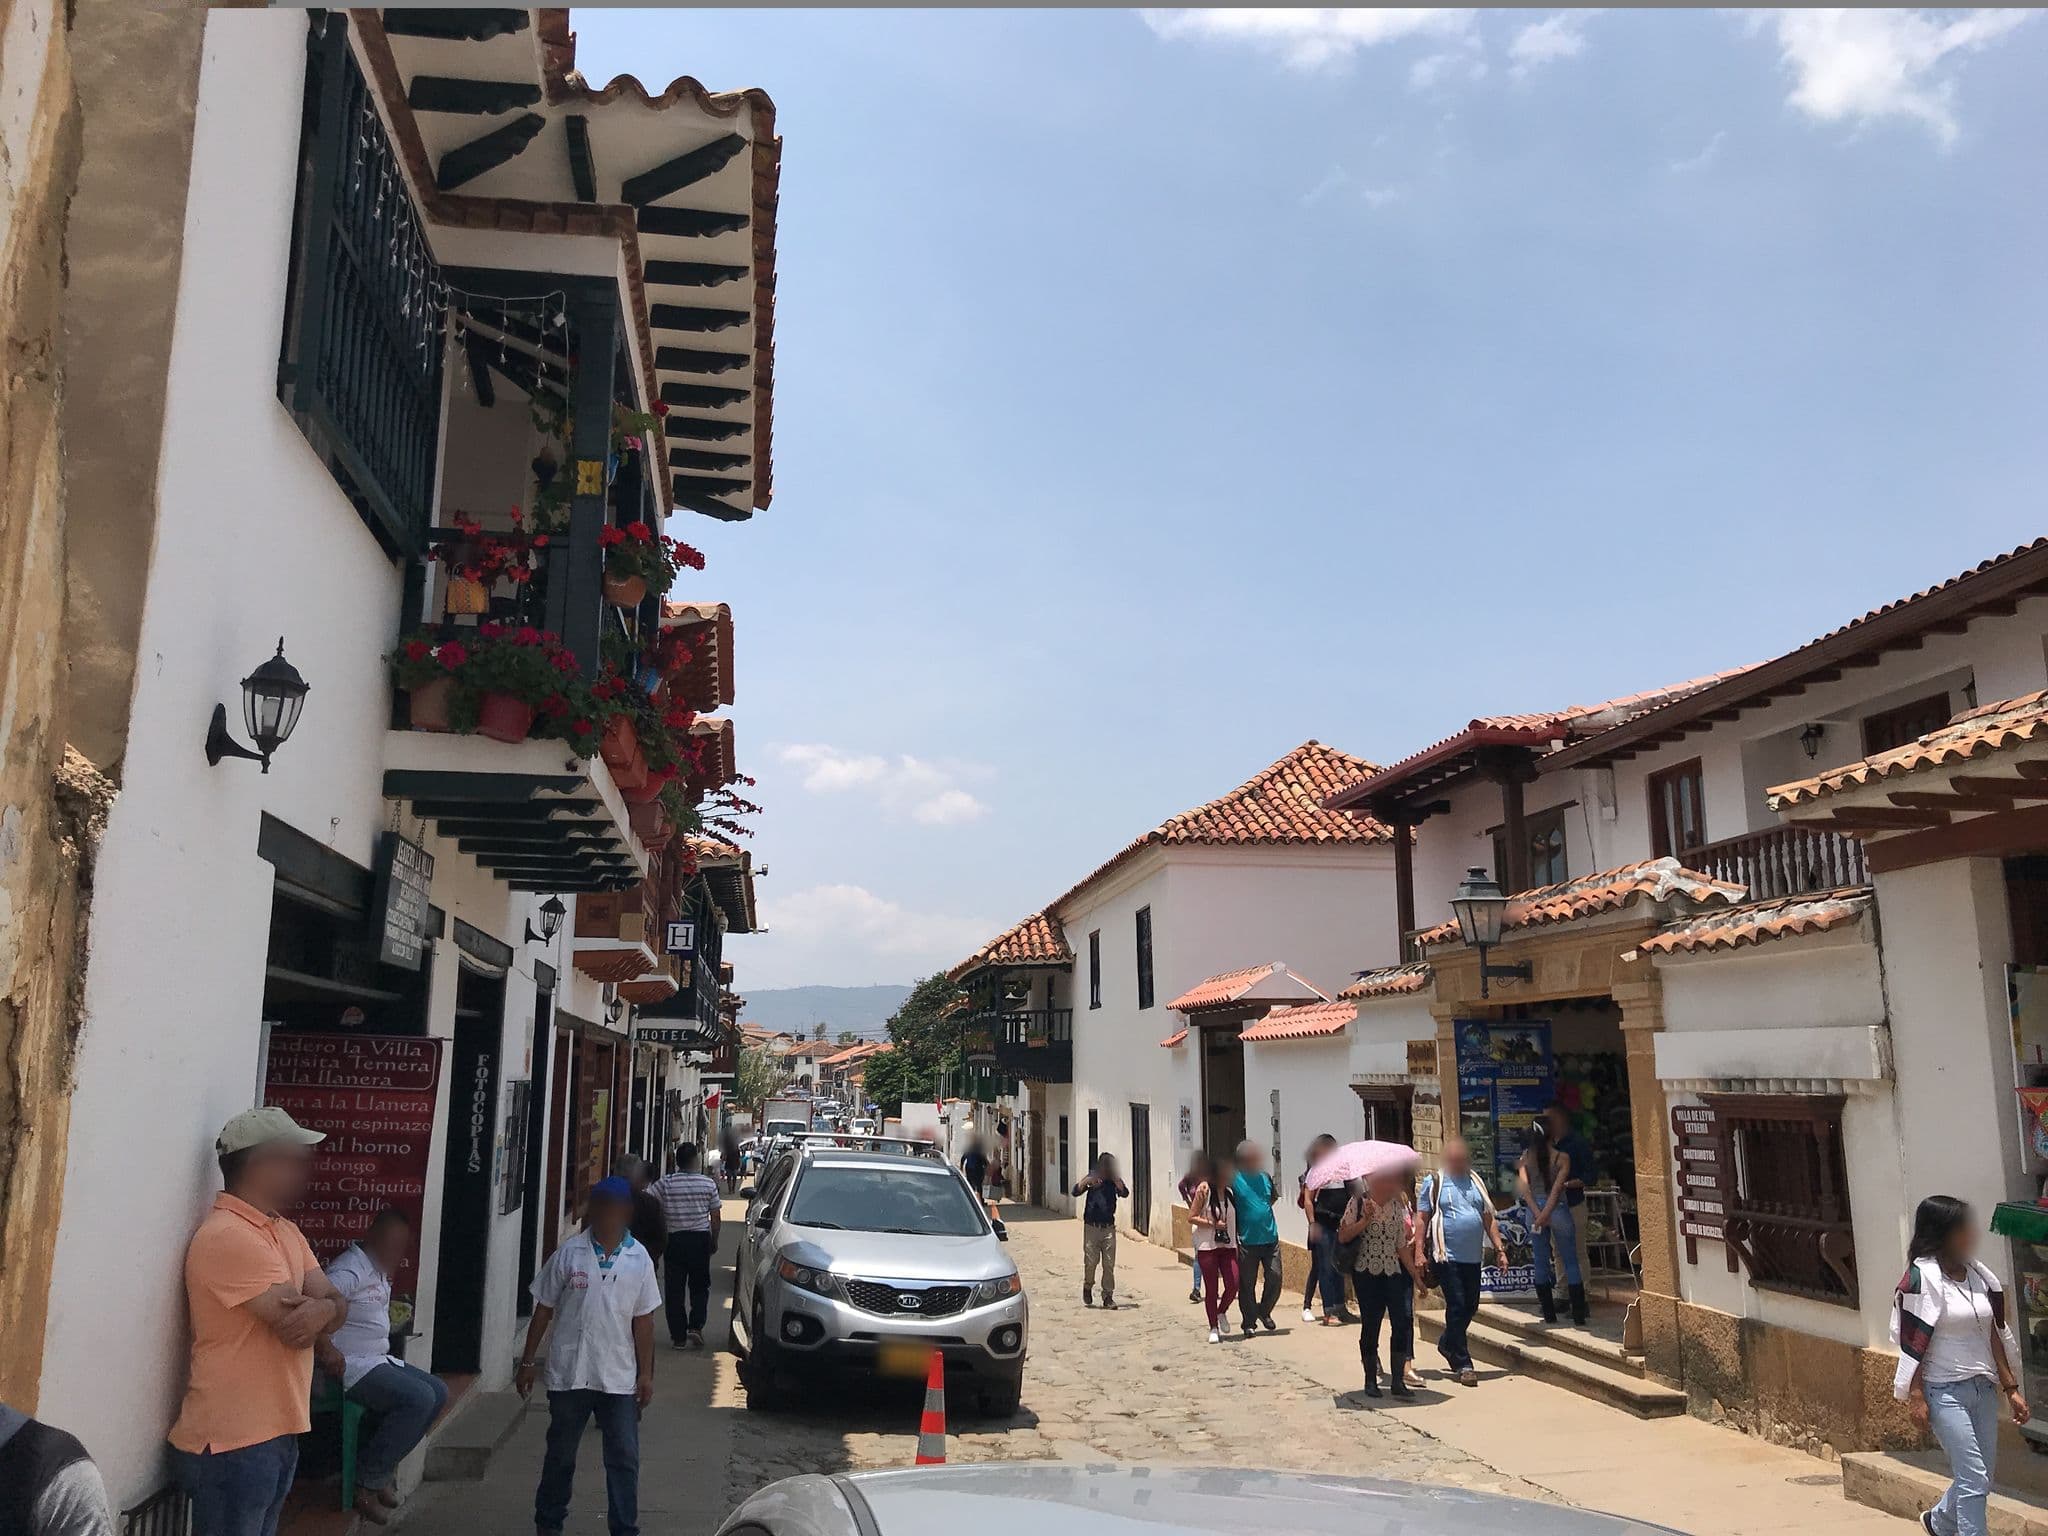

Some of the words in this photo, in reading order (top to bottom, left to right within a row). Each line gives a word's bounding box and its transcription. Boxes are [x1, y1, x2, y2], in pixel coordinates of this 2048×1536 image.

[669, 926, 692, 947] H
[641, 1029, 688, 1041] HOTEL
[344, 1040, 360, 1053] la
[372, 1041, 422, 1057] Villa
[348, 1055, 429, 1072] Ternera
[271, 1073, 282, 1082] a
[292, 1070, 310, 1083] la
[318, 1070, 392, 1086] llanera
[311, 1098, 322, 1109] a
[330, 1095, 346, 1109] la
[355, 1094, 429, 1112] Llanera
[467, 1054, 490, 1173] FOTOCOPIAS
[1676, 1110, 1691, 1120] VILLA
[1691, 1111, 1699, 1121] DE
[314, 1118, 345, 1128] con
[351, 1117, 431, 1133] espinazo
[326, 1137, 344, 1152] al
[351, 1137, 411, 1154] horno
[338, 1177, 422, 1194] Chiquita
[310, 1200, 341, 1209] con
[333, 1214, 373, 1229] Rell
